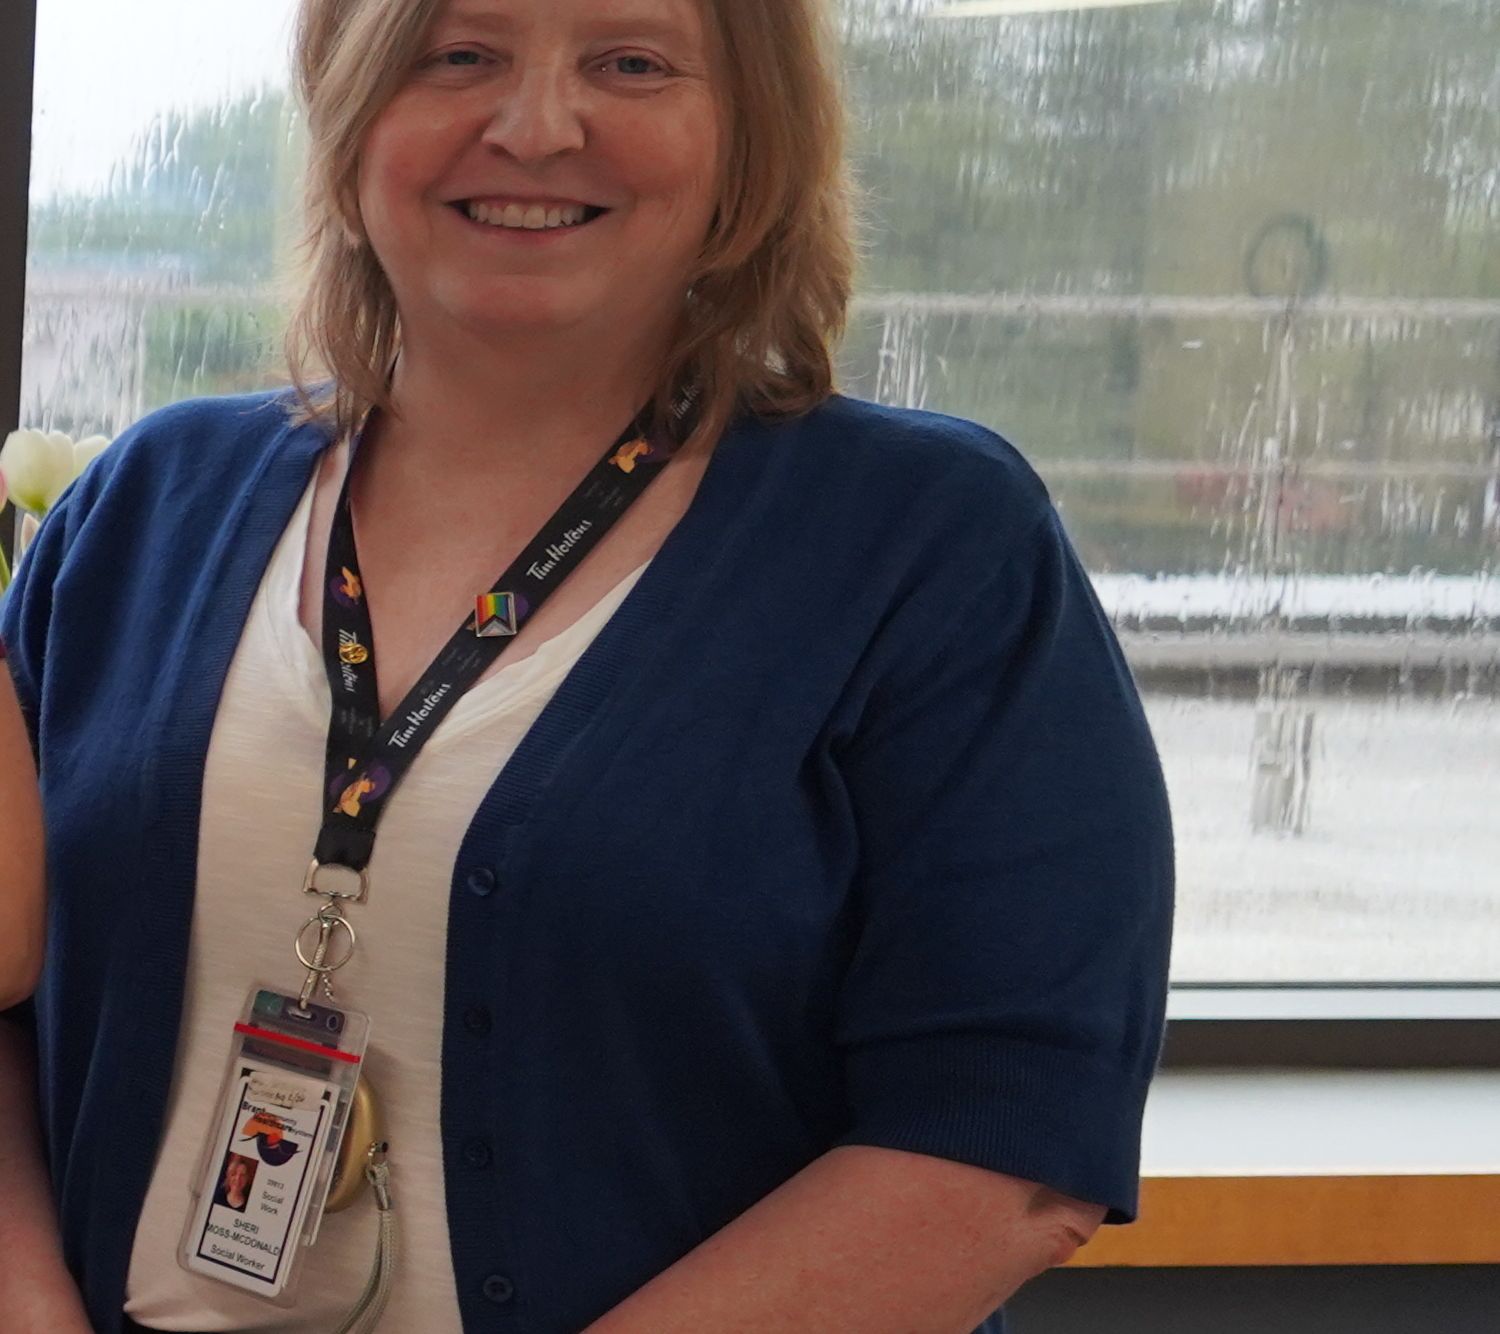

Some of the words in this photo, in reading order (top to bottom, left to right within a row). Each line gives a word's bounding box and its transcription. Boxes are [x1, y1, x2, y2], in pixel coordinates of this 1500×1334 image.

[526, 561, 557, 580] Tim
[545, 519, 593, 561] Hortons
[387, 730, 418, 748] Tim
[406, 683, 452, 726] Hortons
[233, 1218, 260, 1235] SHERI
[211, 1244, 236, 1260] Social
